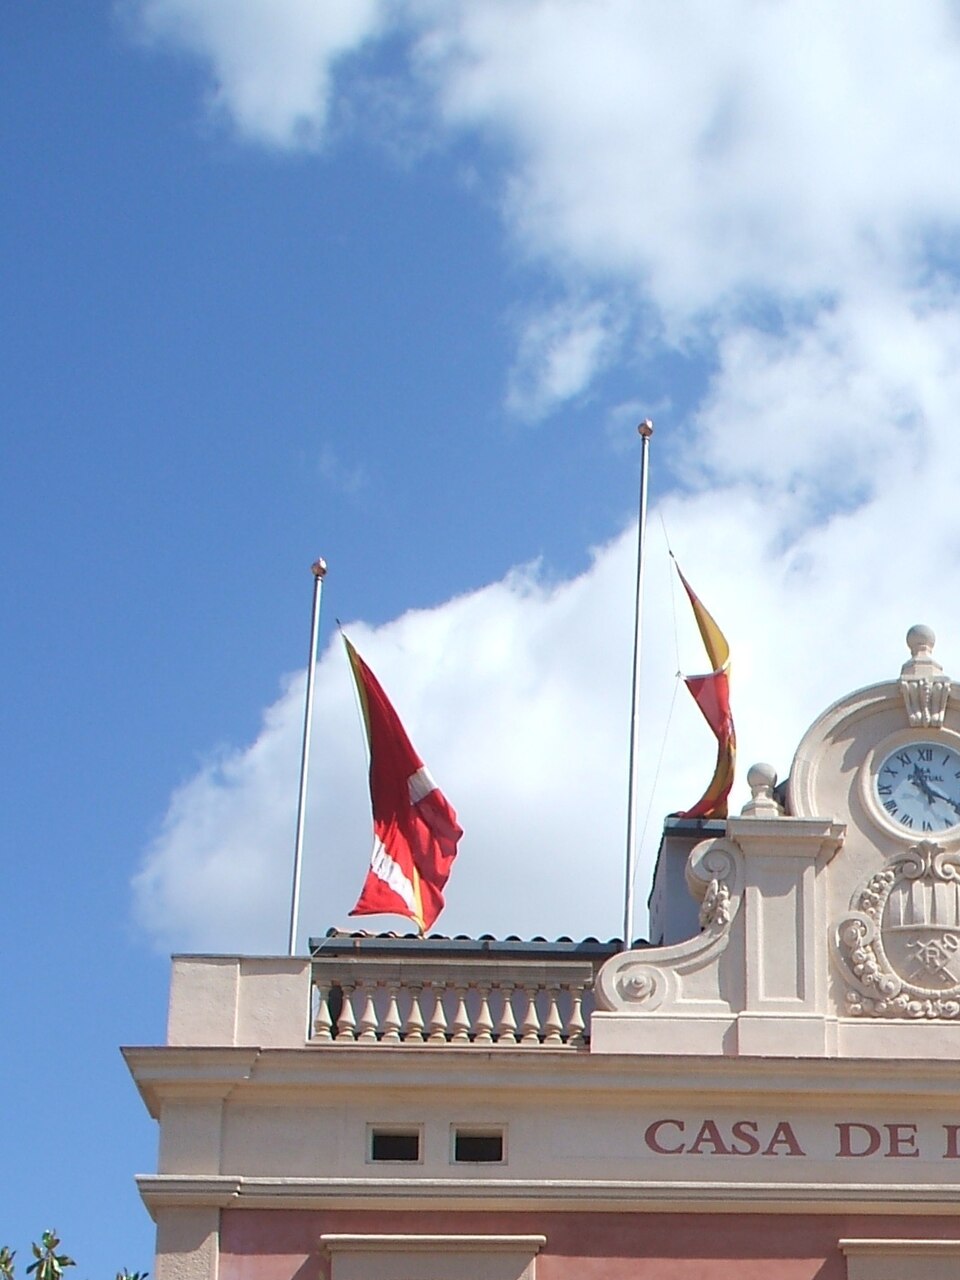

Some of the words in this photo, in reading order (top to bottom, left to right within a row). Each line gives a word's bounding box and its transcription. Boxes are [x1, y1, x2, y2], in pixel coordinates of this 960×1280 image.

[896, 752, 912, 767] XI
[918, 749, 933, 762] XII
[884, 766, 898, 778] X
[900, 814, 913, 828] VII
[922, 821, 933, 832] VI
[644, 1119, 806, 1157] CASA
[834, 1122, 920, 1158] DE
